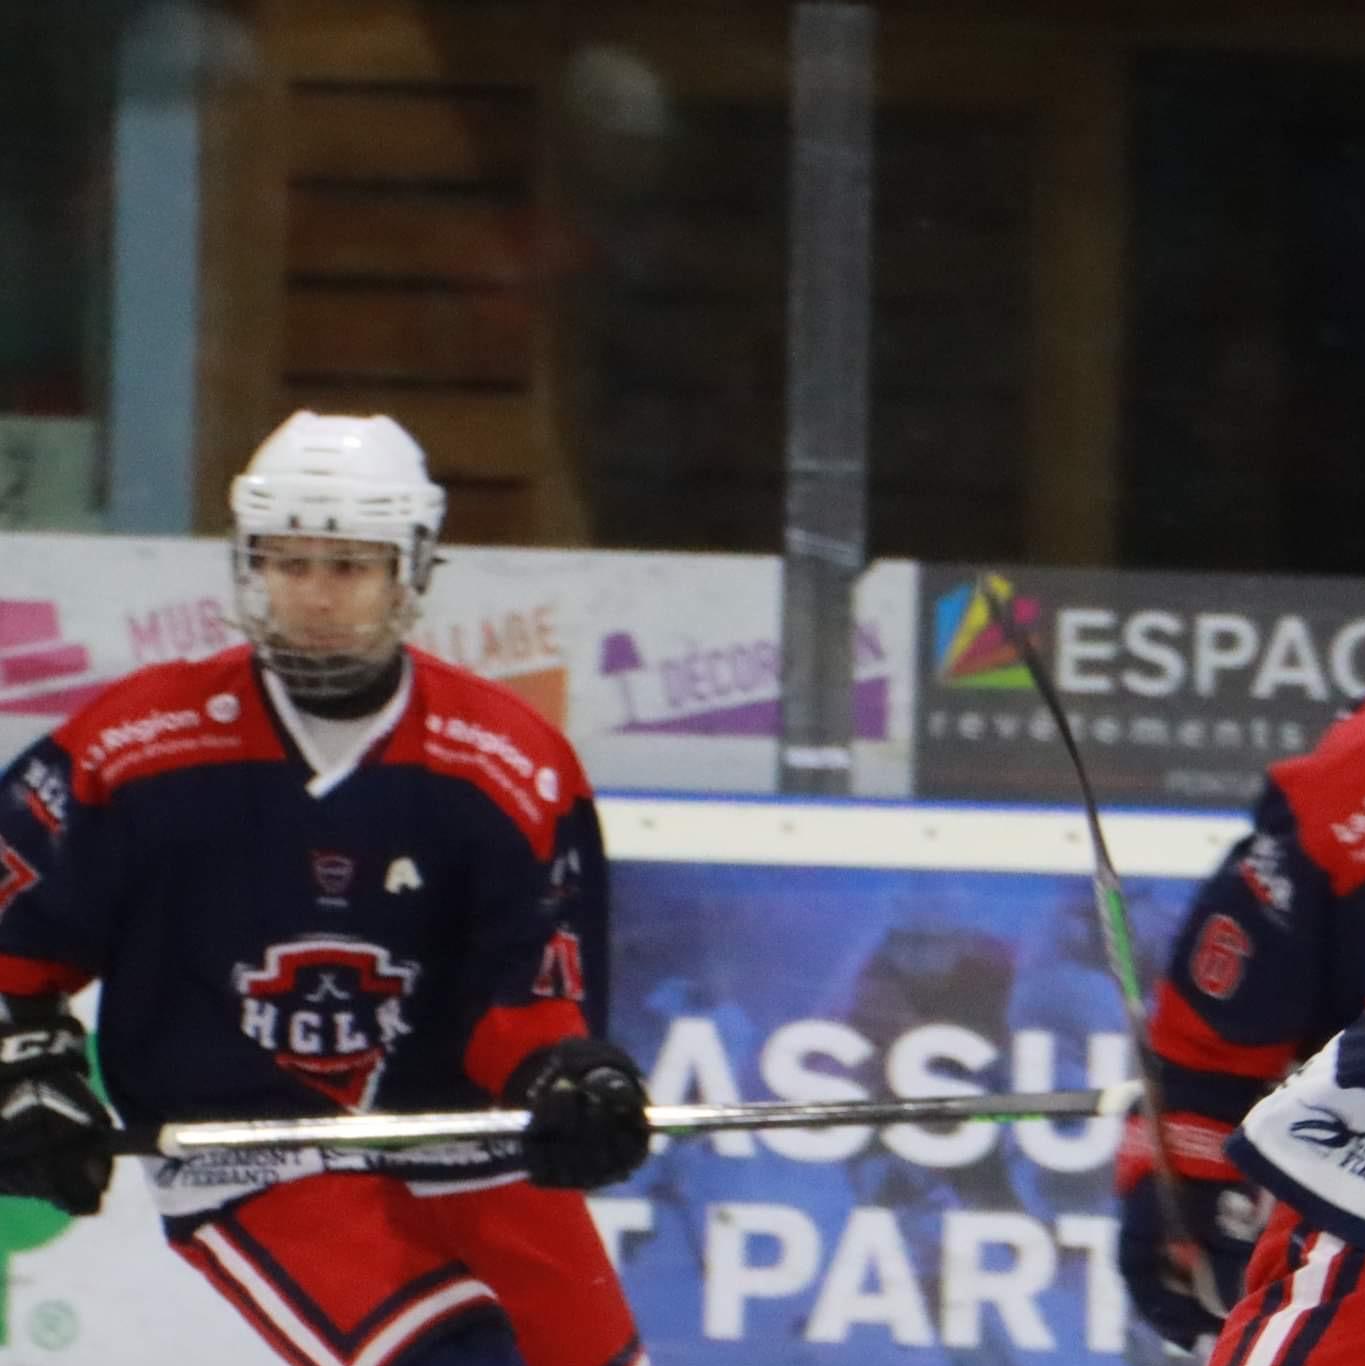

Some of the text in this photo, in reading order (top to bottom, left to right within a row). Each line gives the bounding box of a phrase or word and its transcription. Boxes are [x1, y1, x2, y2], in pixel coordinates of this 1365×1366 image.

[384, 857, 424, 894] A
[648, 1016, 1128, 1172] ASSU
[703, 1203, 1126, 1355] PART
